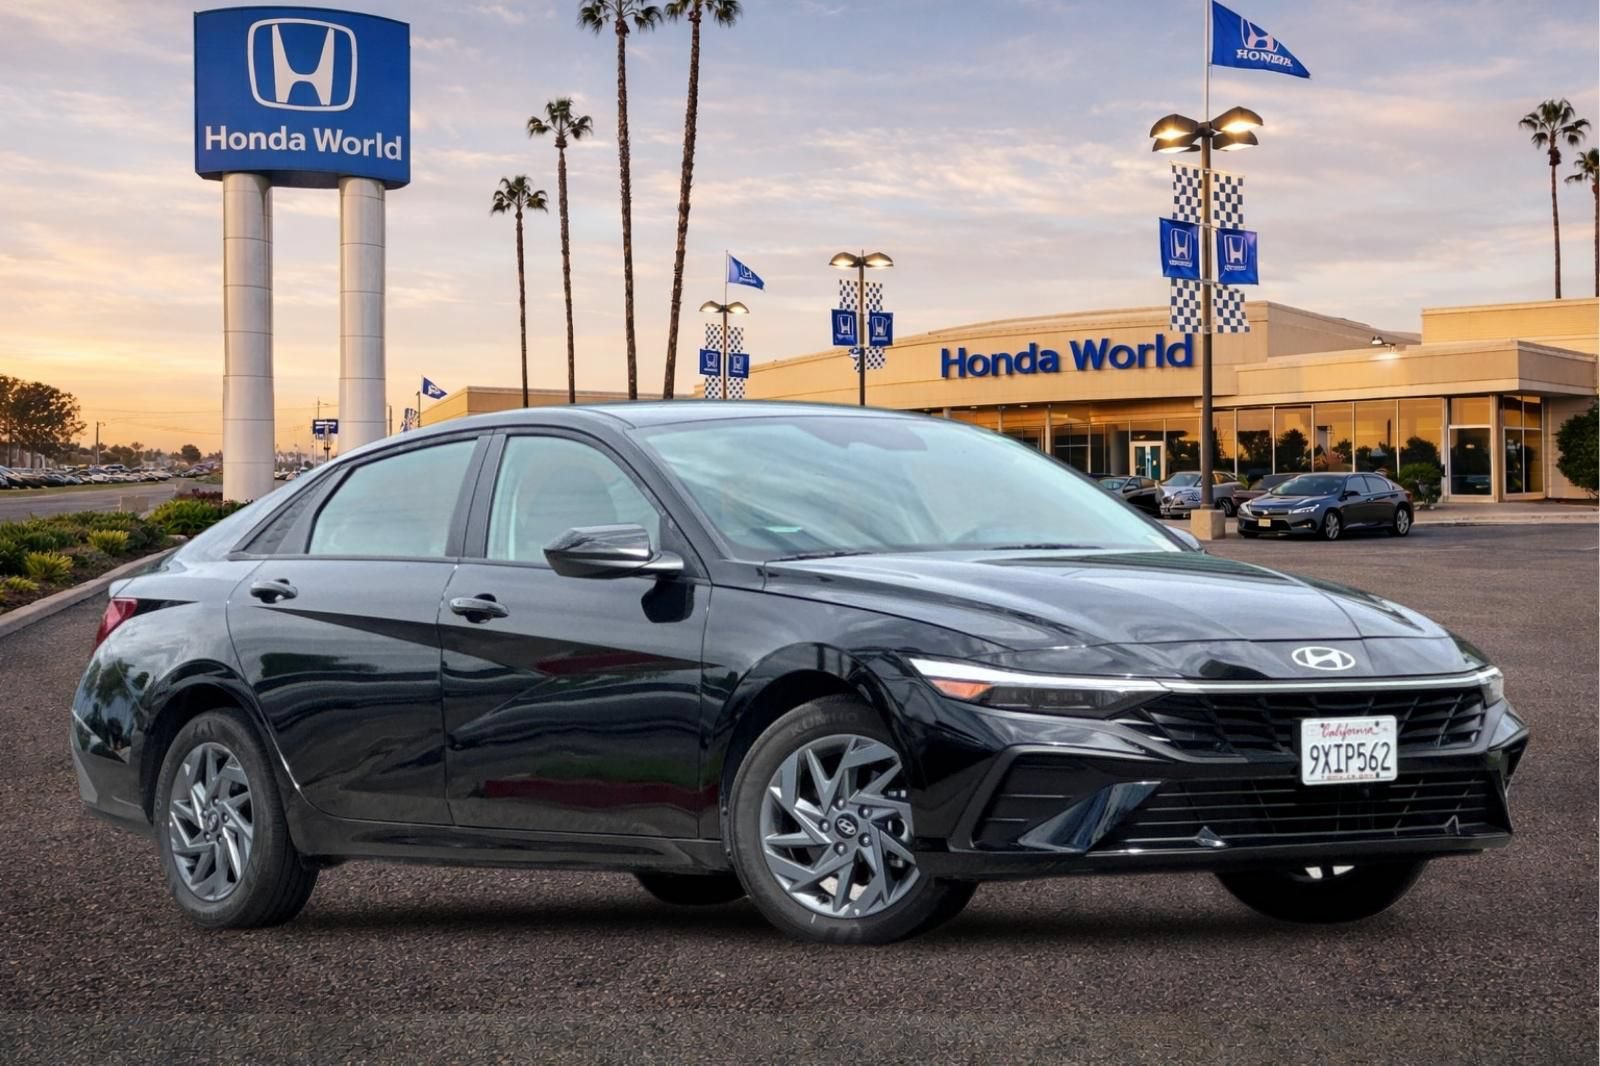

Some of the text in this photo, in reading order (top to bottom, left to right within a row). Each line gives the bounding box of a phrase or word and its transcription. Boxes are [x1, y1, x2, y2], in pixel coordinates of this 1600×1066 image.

[205, 125, 402, 161] Honda World
[941, 332, 1194, 379] Honda World
[1321, 722, 1380, 741] California
[1309, 741, 1392, 775] 9XIP562
